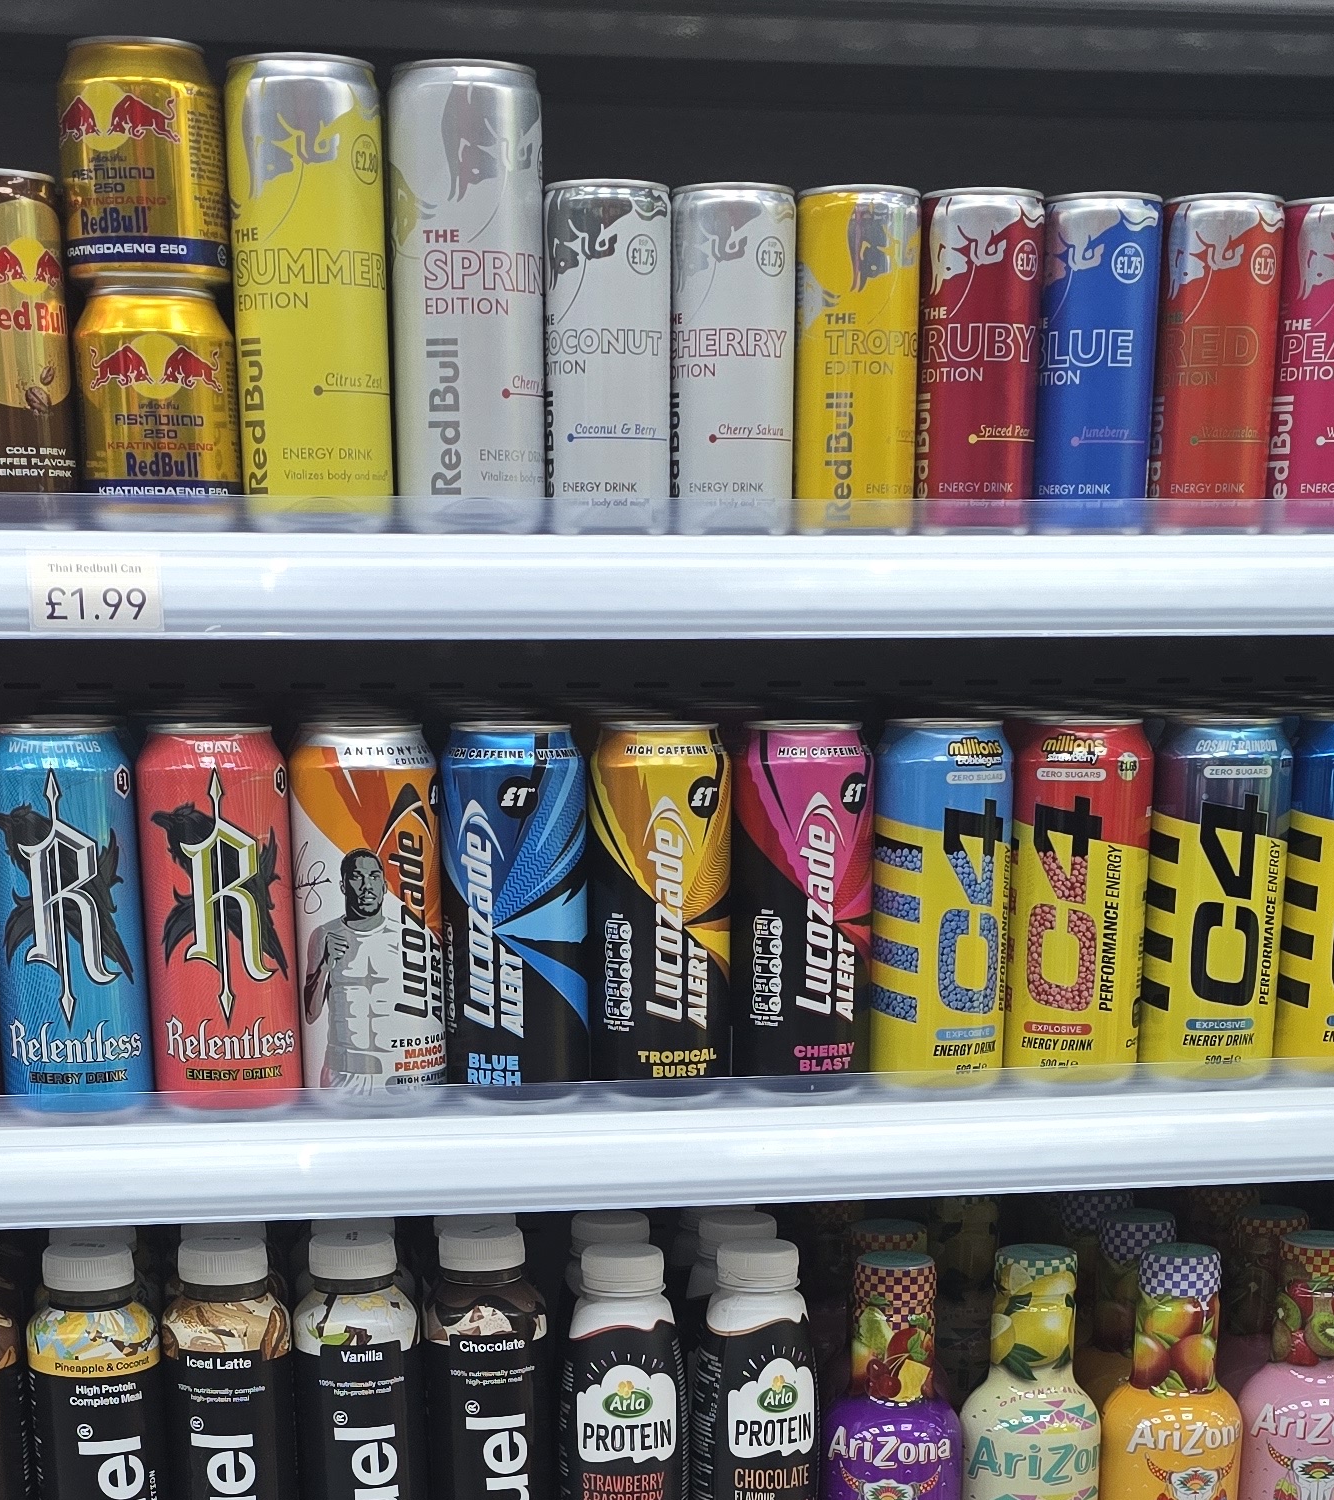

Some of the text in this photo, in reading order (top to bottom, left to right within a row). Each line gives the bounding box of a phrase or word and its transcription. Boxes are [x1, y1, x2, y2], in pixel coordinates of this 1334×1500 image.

[235, 228, 258, 242] THE
[236, 248, 384, 286] SUMMER
[237, 292, 309, 309] EDITION
[923, 324, 1035, 362] RUBY
[325, 373, 382, 388] Citrus Zest
[922, 368, 983, 383] EDITION
[143, 429, 177, 439] 250
[575, 424, 656, 437] Coconut & Berry
[1082, 426, 1129, 440] Juneberry
[6, 446, 66, 455] COLD BREW
[107, 441, 213, 452] KRATINGDAENG
[282, 448, 373, 460] ENERGY DRINK
[48, 562, 141, 573] Thai Redbull Can
[46, 586, 147, 621] £1.99
[8, 740, 101, 753] WHITE CITRUS
[625, 744, 705, 757] HIGH CAFFEINE
[948, 740, 1002, 758] millions
[1041, 770, 1102, 780] ZERO SUGARS
[463, 827, 495, 1028] Lucozade
[1099, 845, 1123, 1011] PERFORMANCE ENERGY
[495, 947, 525, 1039] ALERT
[1031, 1023, 1083, 1033] EXPLOSIVE
[468, 1054, 518, 1070] BLUE
[468, 1069, 521, 1086] RUSH
[55, 1355, 149, 1373] Pineapple & Coconut
[341, 1350, 383, 1363] Vanilla
[608, 1394, 646, 1411] Arla
[583, 1419, 672, 1452] PROTEIN
[828, 1427, 952, 1468] AriZona
[582, 1473, 664, 1492] STRAWBERRY
[735, 1465, 809, 1489] CHOCOLATE
